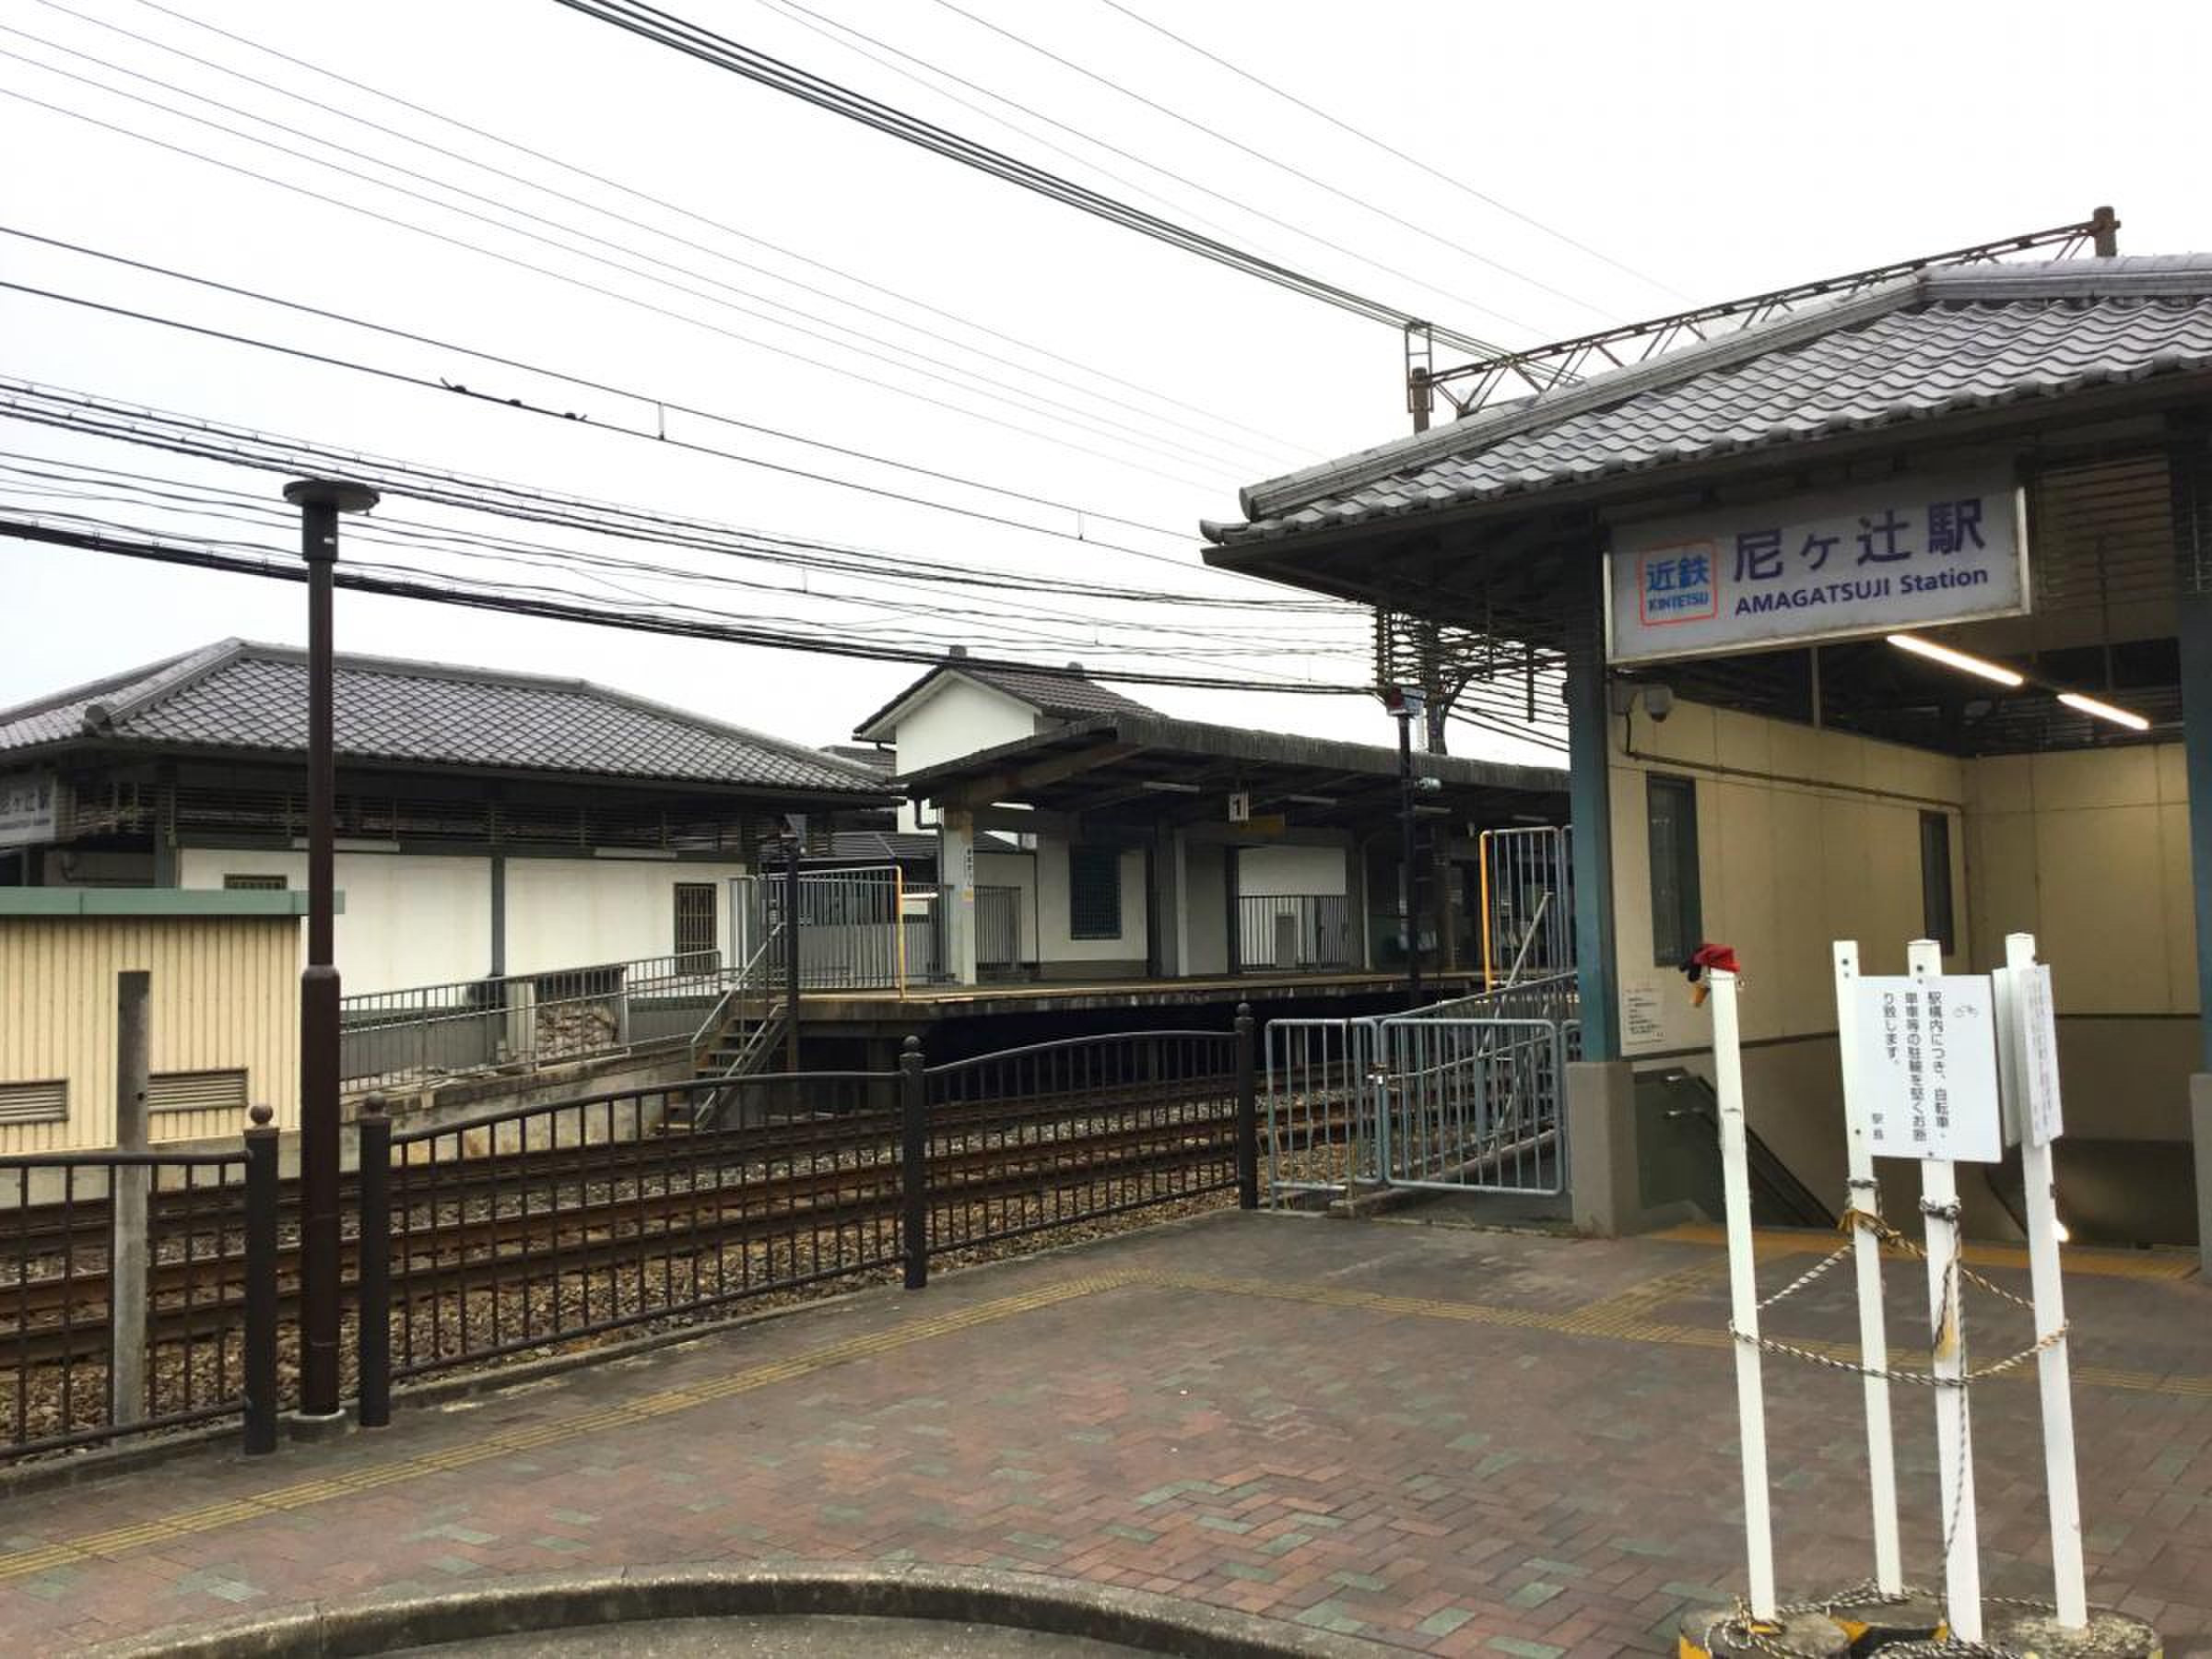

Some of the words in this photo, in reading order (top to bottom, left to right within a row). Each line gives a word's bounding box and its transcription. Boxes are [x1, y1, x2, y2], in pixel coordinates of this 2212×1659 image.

[1645, 555, 1710, 591] 近鉄
[1734, 578, 1890, 617] AMAGATSUJI
[1900, 565, 1989, 594] Station
[1648, 592, 1709, 612] KINTETSU
